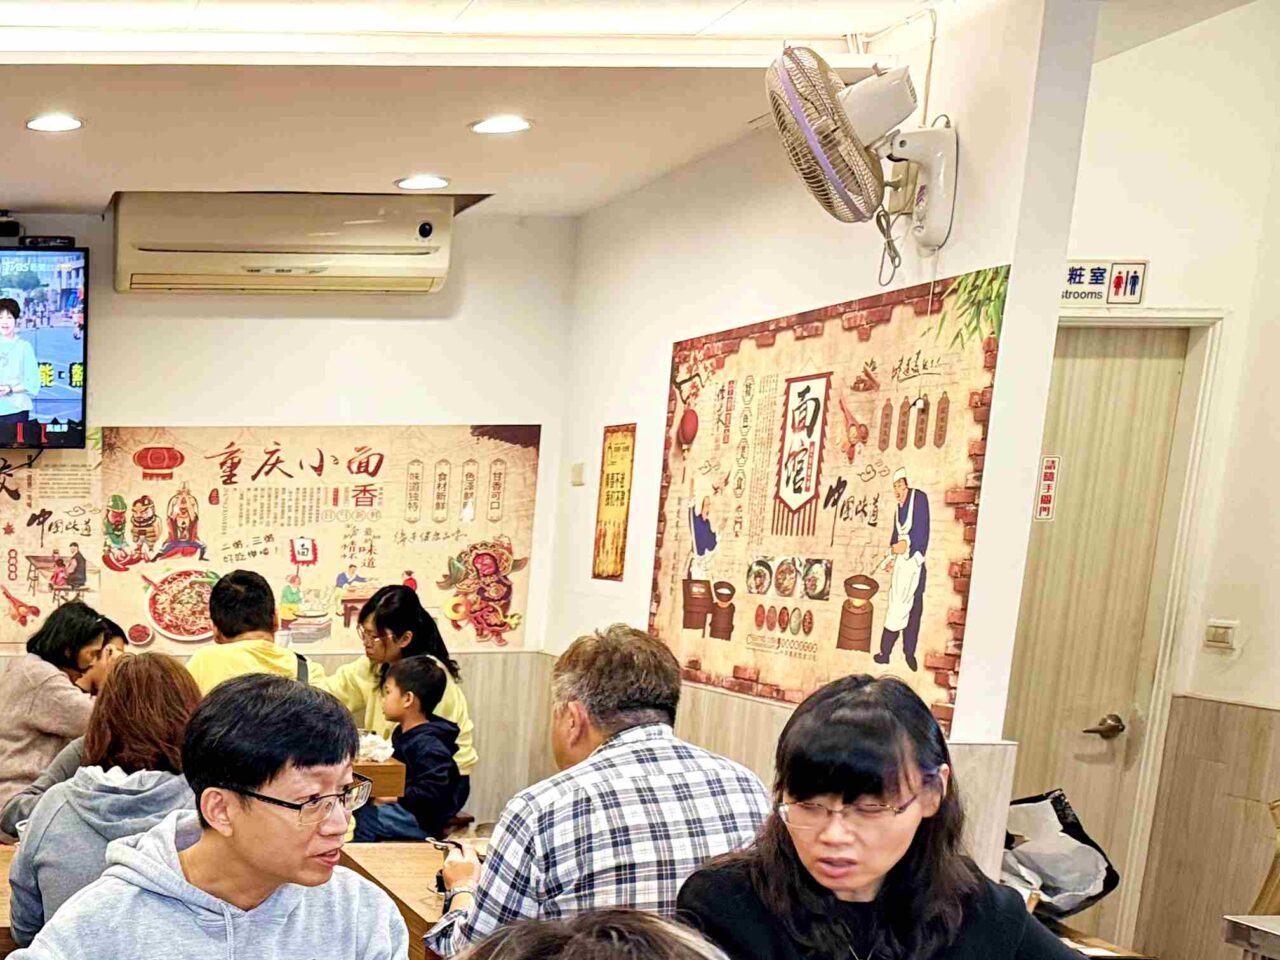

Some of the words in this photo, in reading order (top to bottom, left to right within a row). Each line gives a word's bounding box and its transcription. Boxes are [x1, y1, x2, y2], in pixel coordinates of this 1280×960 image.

[204, 440, 384, 485] 重庆小面
[352, 483, 378, 507] 香
[489, 471, 503, 510] 甘香可口
